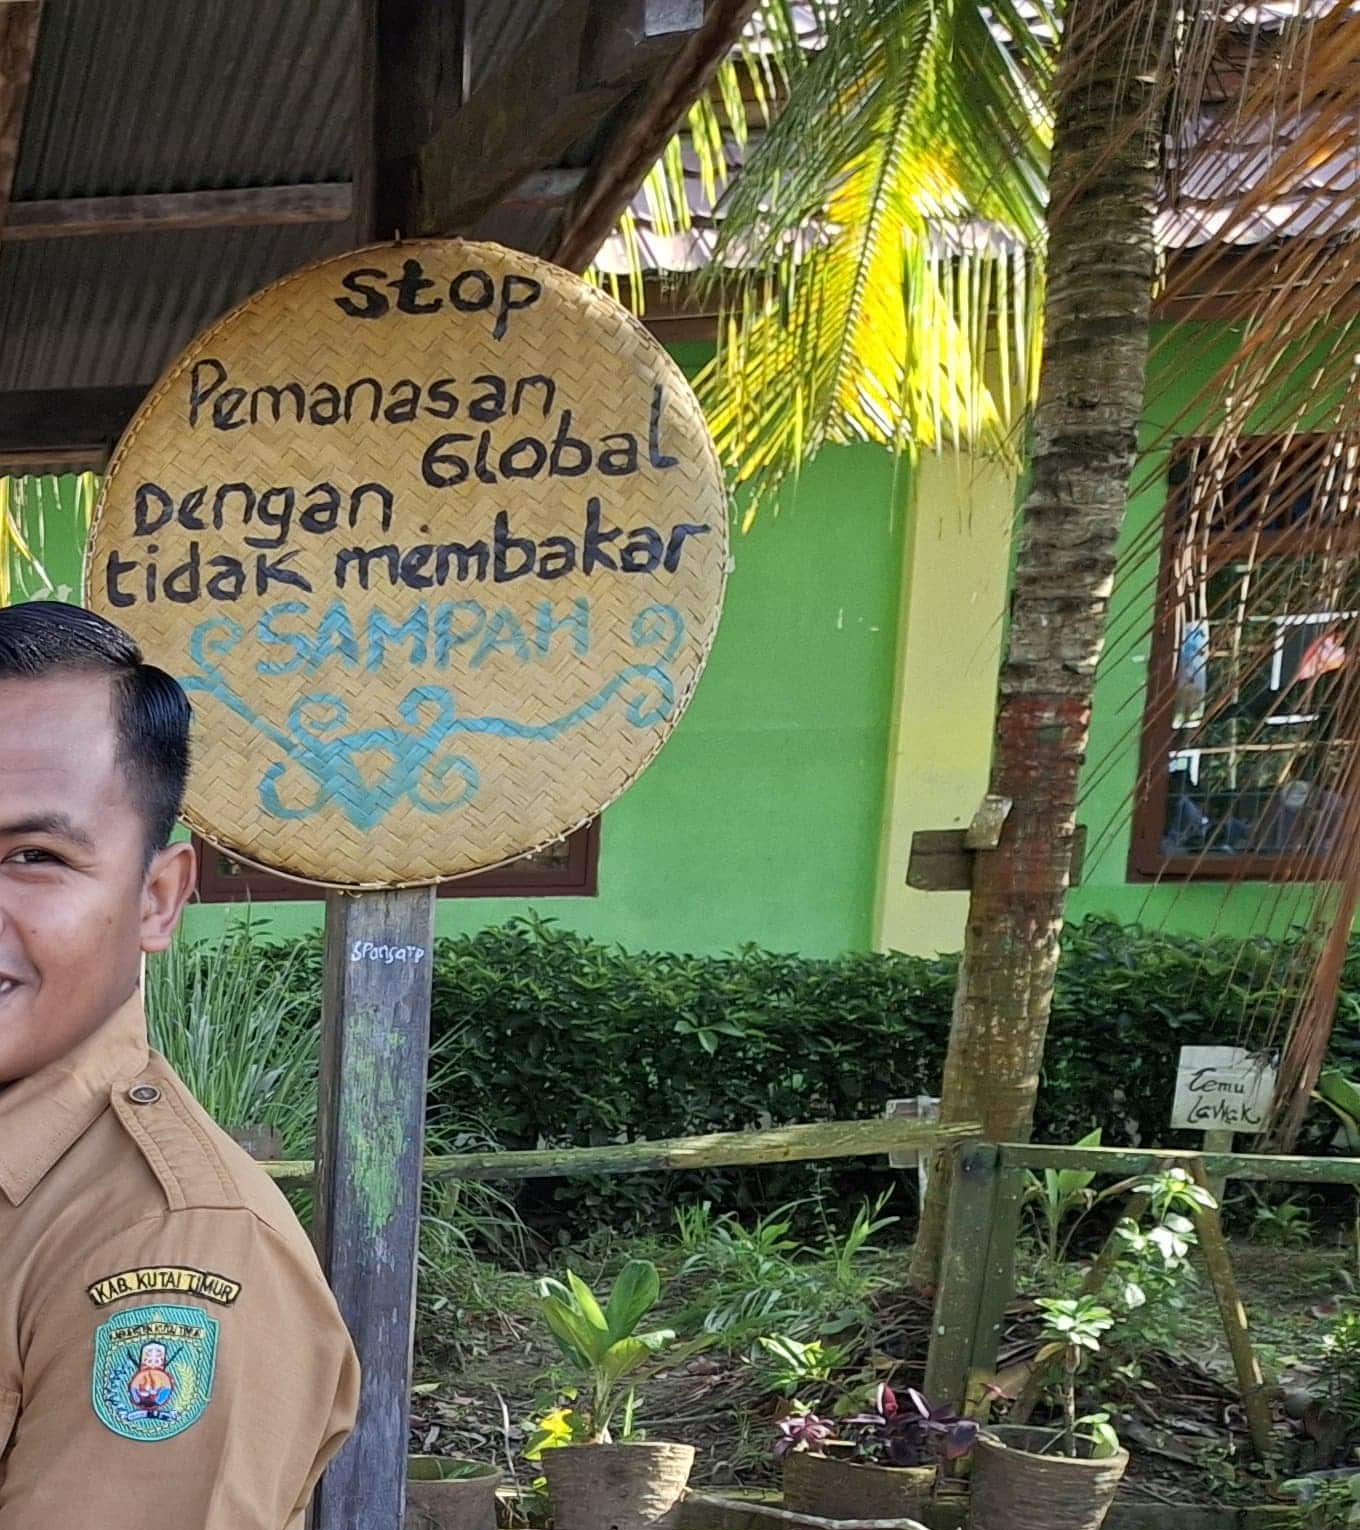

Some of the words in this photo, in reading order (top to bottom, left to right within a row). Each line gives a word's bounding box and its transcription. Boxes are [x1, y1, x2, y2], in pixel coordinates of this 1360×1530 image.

[188, 357, 556, 430] Pemanasan
[421, 384, 679, 488] Global
[105, 541, 314, 607] tidak
[333, 497, 712, 590] membakar
[132, 480, 394, 549] Dengan
[253, 597, 591, 676] SAMPAH
[136, 1271, 181, 1291] KUTAI
[184, 1274, 234, 1300] TIMUR
